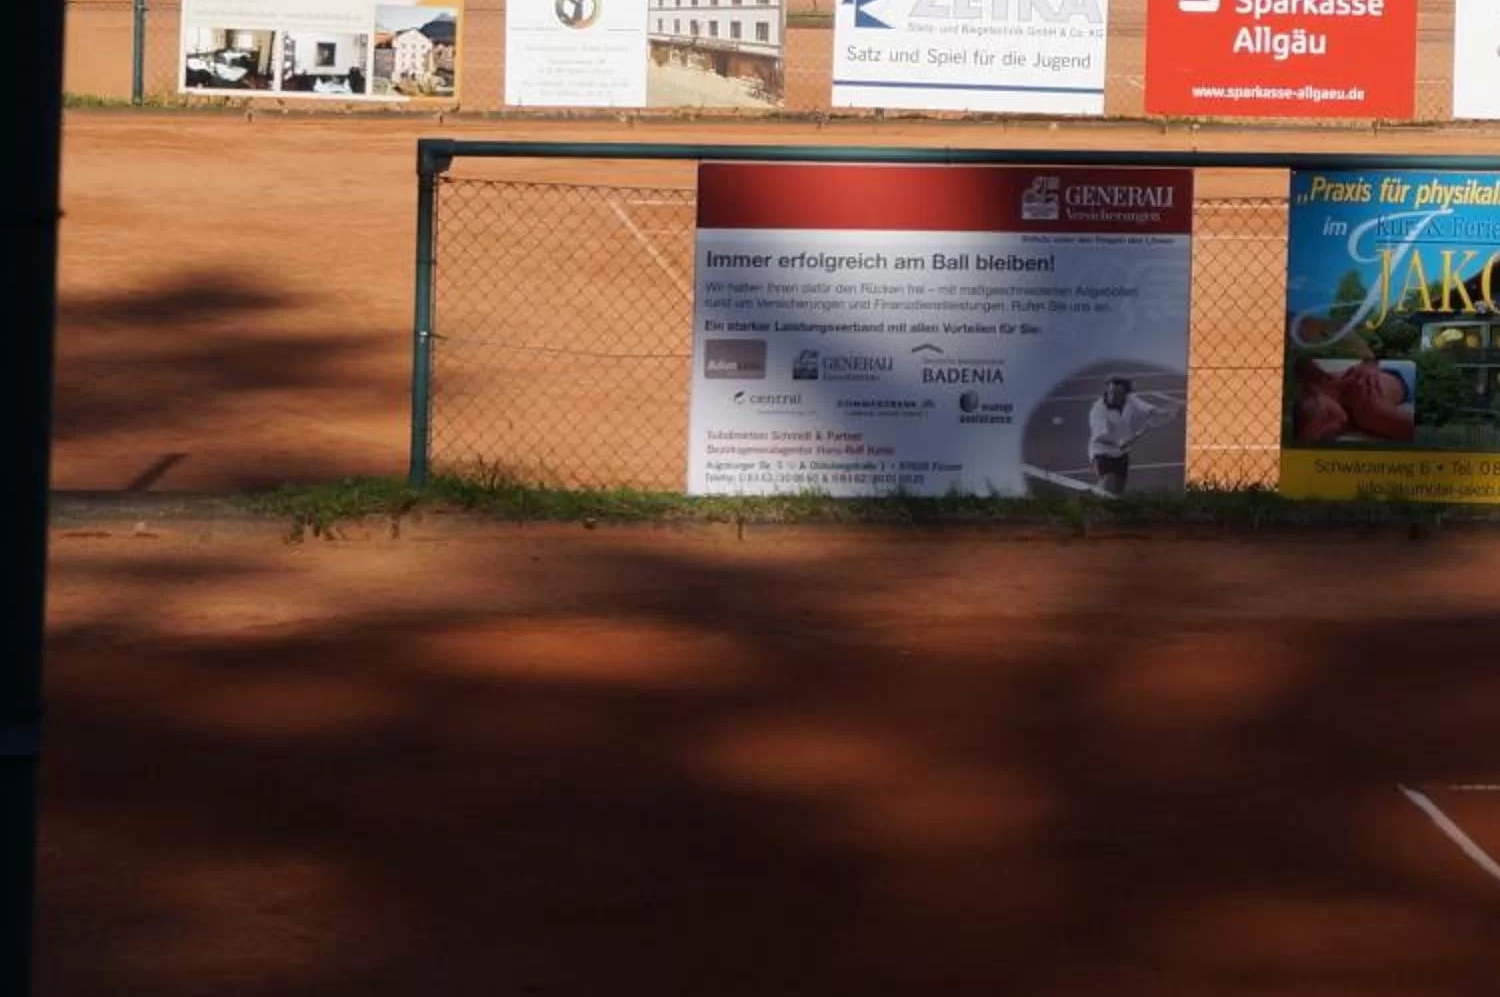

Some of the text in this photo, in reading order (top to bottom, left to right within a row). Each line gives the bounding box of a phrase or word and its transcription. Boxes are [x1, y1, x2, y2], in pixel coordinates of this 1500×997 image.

[1232, 27, 1327, 61] Allgäu
[847, 45, 1092, 72] Satz und Spiel für die Jugend
[1191, 84, 1366, 103] www.sparkasse-allgaeu.de
[1065, 185, 1175, 208] GENERALI
[1379, 177, 1411, 204] für
[1322, 215, 1348, 236] im
[1426, 218, 1442, 237] &
[706, 250, 1056, 273] Immer erfolgreich am Ball bleiben!
[887, 321, 907, 333] mit
[910, 322, 939, 334] allen
[822, 356, 893, 372] GENERALI
[922, 367, 1005, 384] BADENIA
